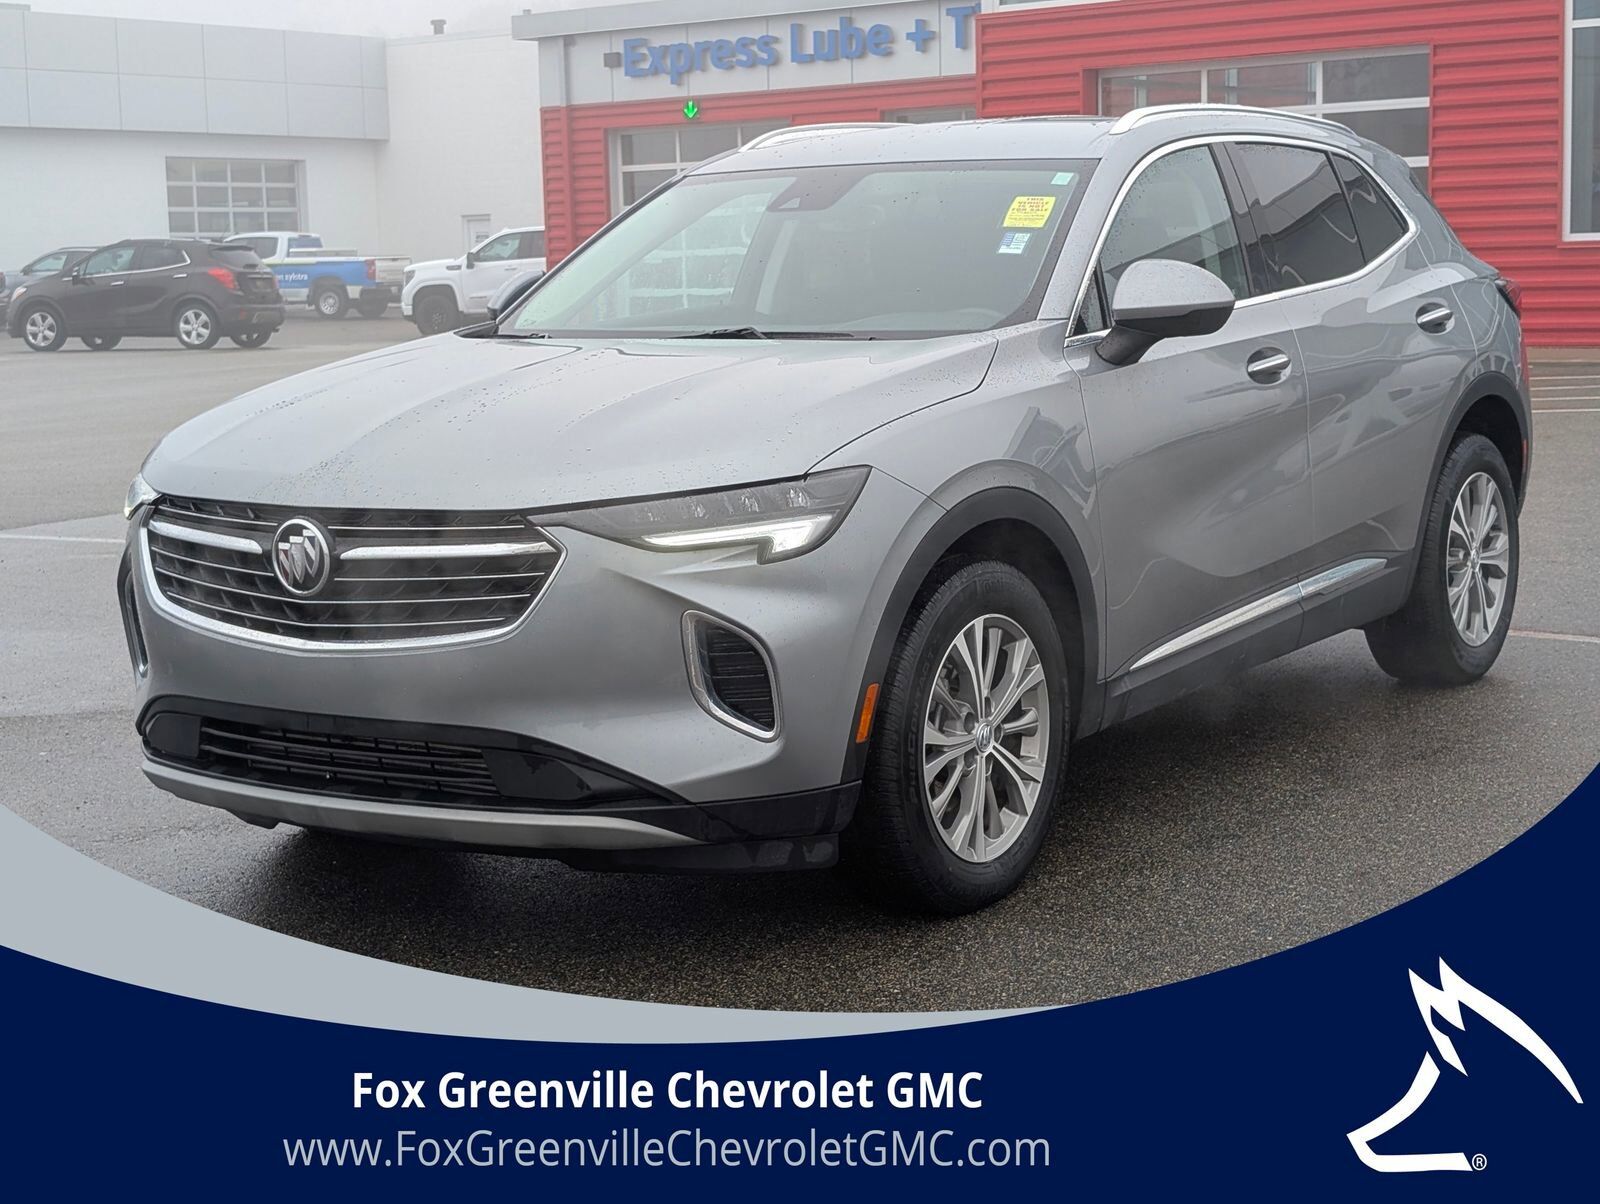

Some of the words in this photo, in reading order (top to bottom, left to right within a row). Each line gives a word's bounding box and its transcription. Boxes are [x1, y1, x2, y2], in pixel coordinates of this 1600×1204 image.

[624, 34, 779, 86] Express
[790, 16, 894, 64] Lube
[946, 2, 981, 49] T
